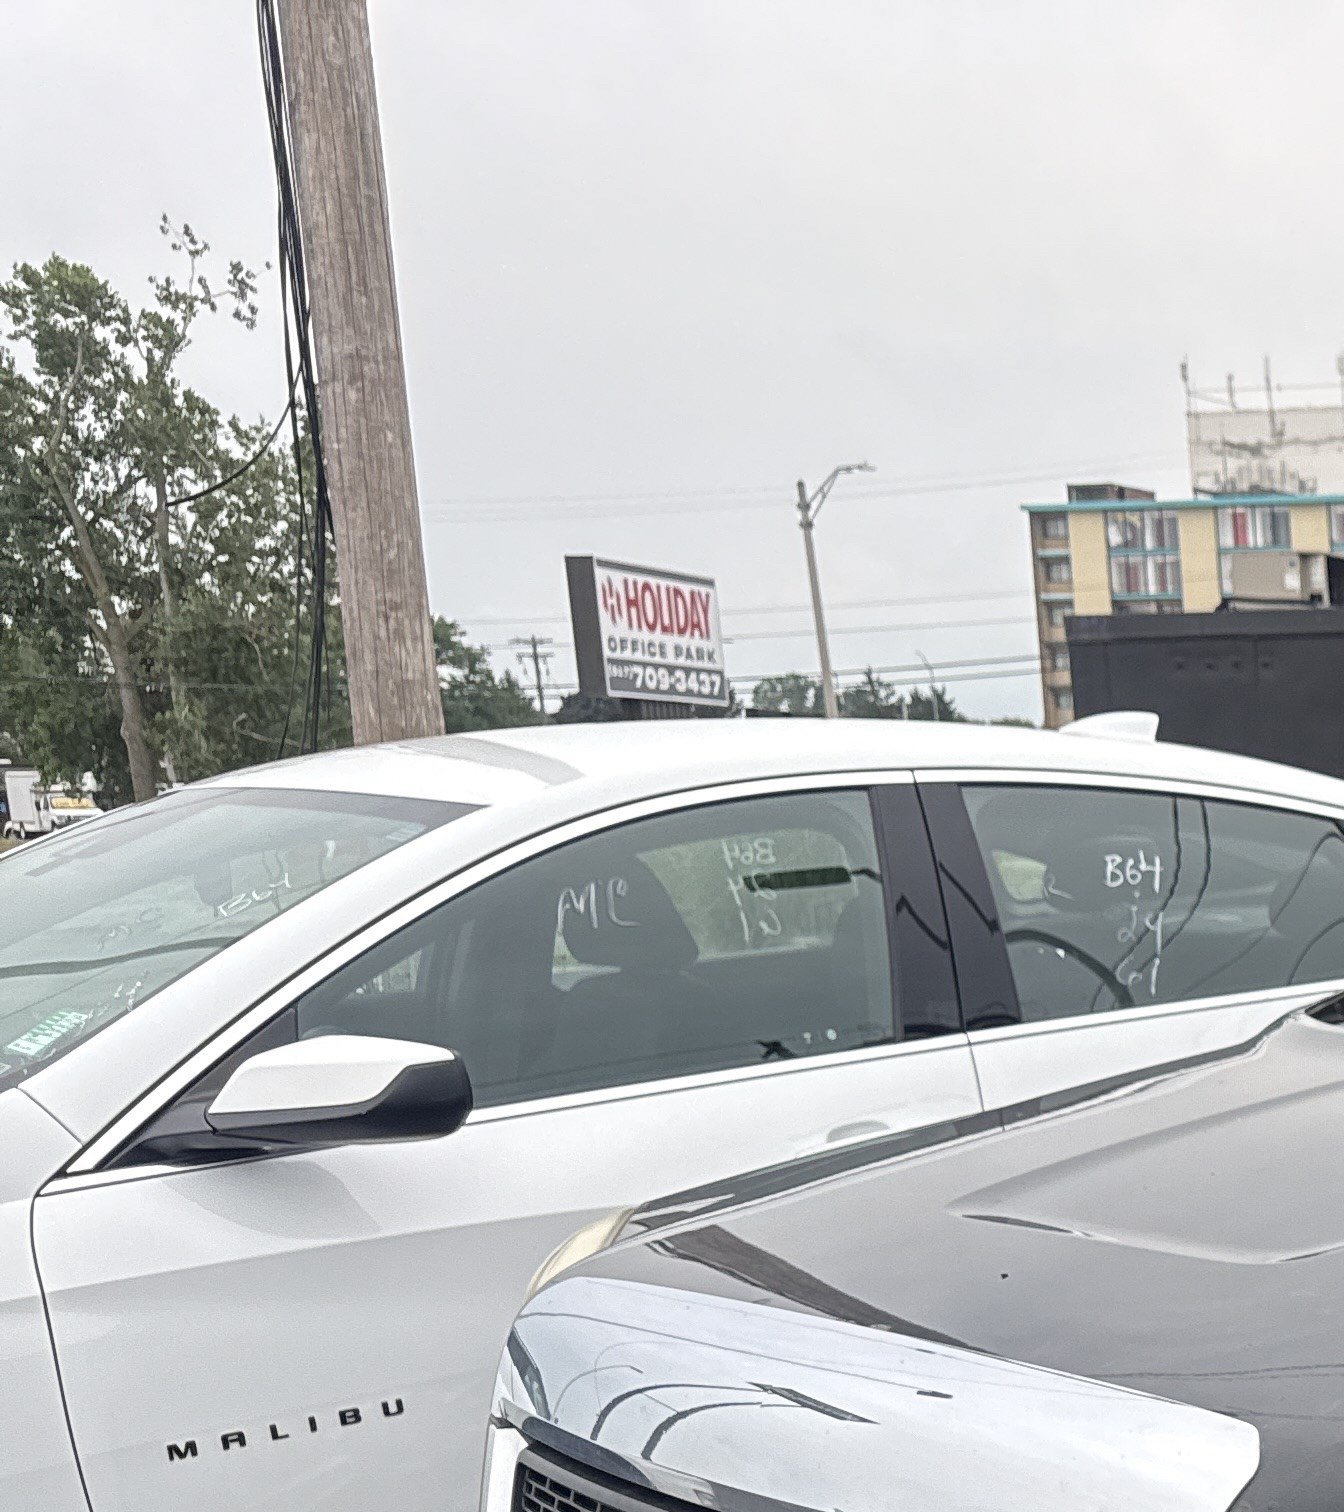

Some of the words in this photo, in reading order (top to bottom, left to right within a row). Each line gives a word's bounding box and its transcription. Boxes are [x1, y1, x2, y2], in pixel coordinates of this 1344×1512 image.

[623, 577, 711, 641] HOLIDAY
[607, 635, 668, 660] OFFICE
[674, 644, 717, 664] PARK
[1103, 850, 1163, 893] B64
[166, 1398, 404, 1461] MALIBU
